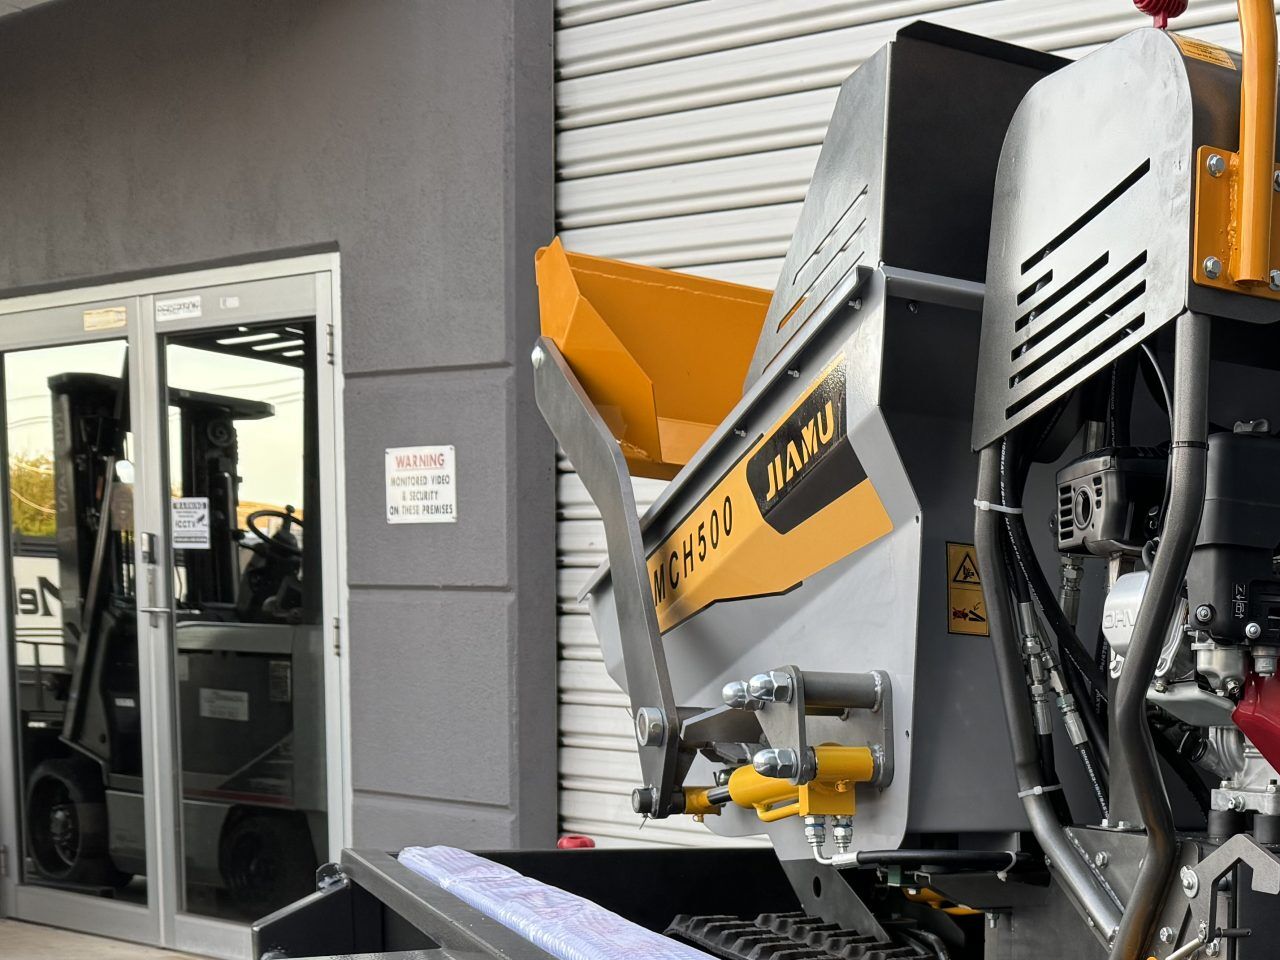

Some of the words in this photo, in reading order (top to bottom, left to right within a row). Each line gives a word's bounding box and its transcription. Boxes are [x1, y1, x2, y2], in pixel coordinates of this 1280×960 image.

[766, 400, 835, 502] JIAMU
[395, 453, 445, 468] WARNING
[390, 475, 428, 487] MONITORED
[431, 474, 450, 485] VIDEO
[409, 490, 438, 501] SECURITY
[389, 505, 399, 516] ON
[402, 504, 420, 515] THESE
[422, 503, 453, 515] PREMISES
[654, 495, 733, 607] MCH500
